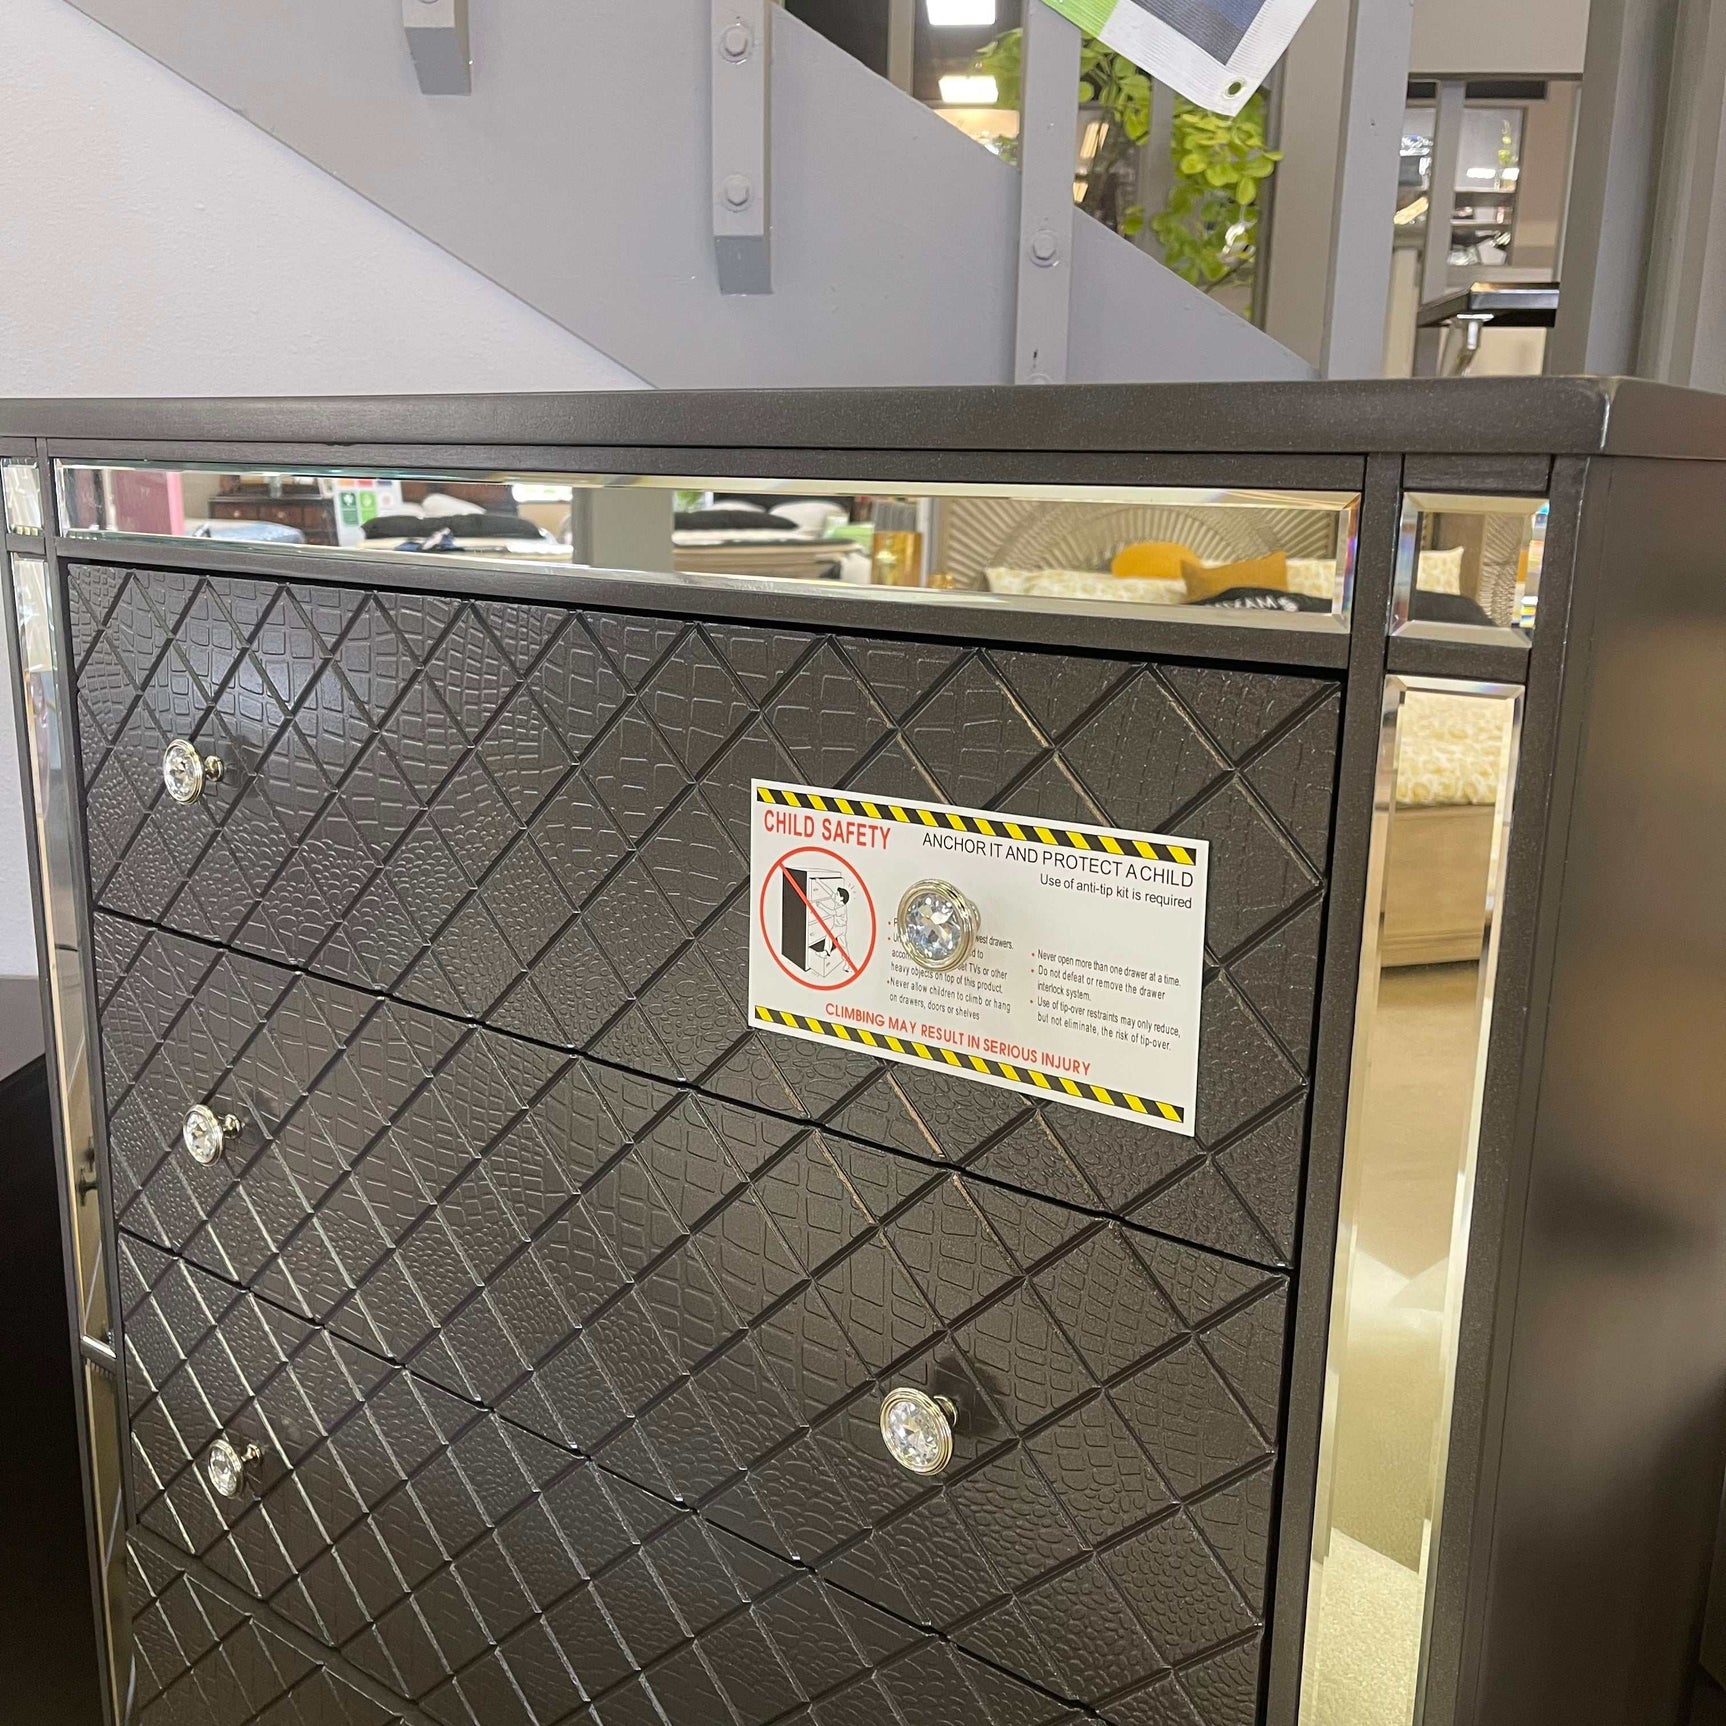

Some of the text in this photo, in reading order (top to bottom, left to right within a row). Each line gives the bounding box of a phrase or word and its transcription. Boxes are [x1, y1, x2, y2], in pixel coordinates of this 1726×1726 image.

[765, 810, 891, 849] CHILD SAFETY
[922, 832, 1194, 888] ANCHOR IT AND PROTECT A CHILD
[1040, 873, 1192, 909] Use of anti-tip kit is required
[977, 950, 983, 959] to
[989, 936, 1013, 949] drawers.
[891, 962, 910, 976] heavy
[911, 966, 933, 978] objects
[944, 973, 954, 984] top
[956, 976, 962, 984] of
[964, 977, 975, 987] this
[969, 963, 980, 974] TVs
[983, 967, 989, 976] or
[991, 968, 1007, 980] other
[1038, 949, 1056, 962] Never
[1058, 955, 1074, 966] open
[1075, 959, 1092, 969] more
[1093, 961, 1108, 972] than
[1110, 965, 1123, 974] one
[1124, 966, 1148, 980] drawer
[1149, 971, 1156, 981] at
[1158, 974, 1162, 982] a
[1039, 965, 1165, 1000] Do not defeat or remove the drawer
[891, 978, 1011, 1013] Never allow children to climb or hang
[900, 994, 926, 1009] drawers,
[928, 1001, 945, 1013] doors
[947, 1006, 954, 1014] or
[956, 1007, 980, 1020] shelves
[1038, 982, 1091, 1001] interlock system.
[1038, 997, 1180, 1038] Use of tip-over restraints may only reduce,
[1038, 1013, 1171, 1050] but not eliminate, the risk of tip-over.
[825, 1002, 1090, 1075] CLIMBING MAY RESULT IN SERIOUS INJURY
